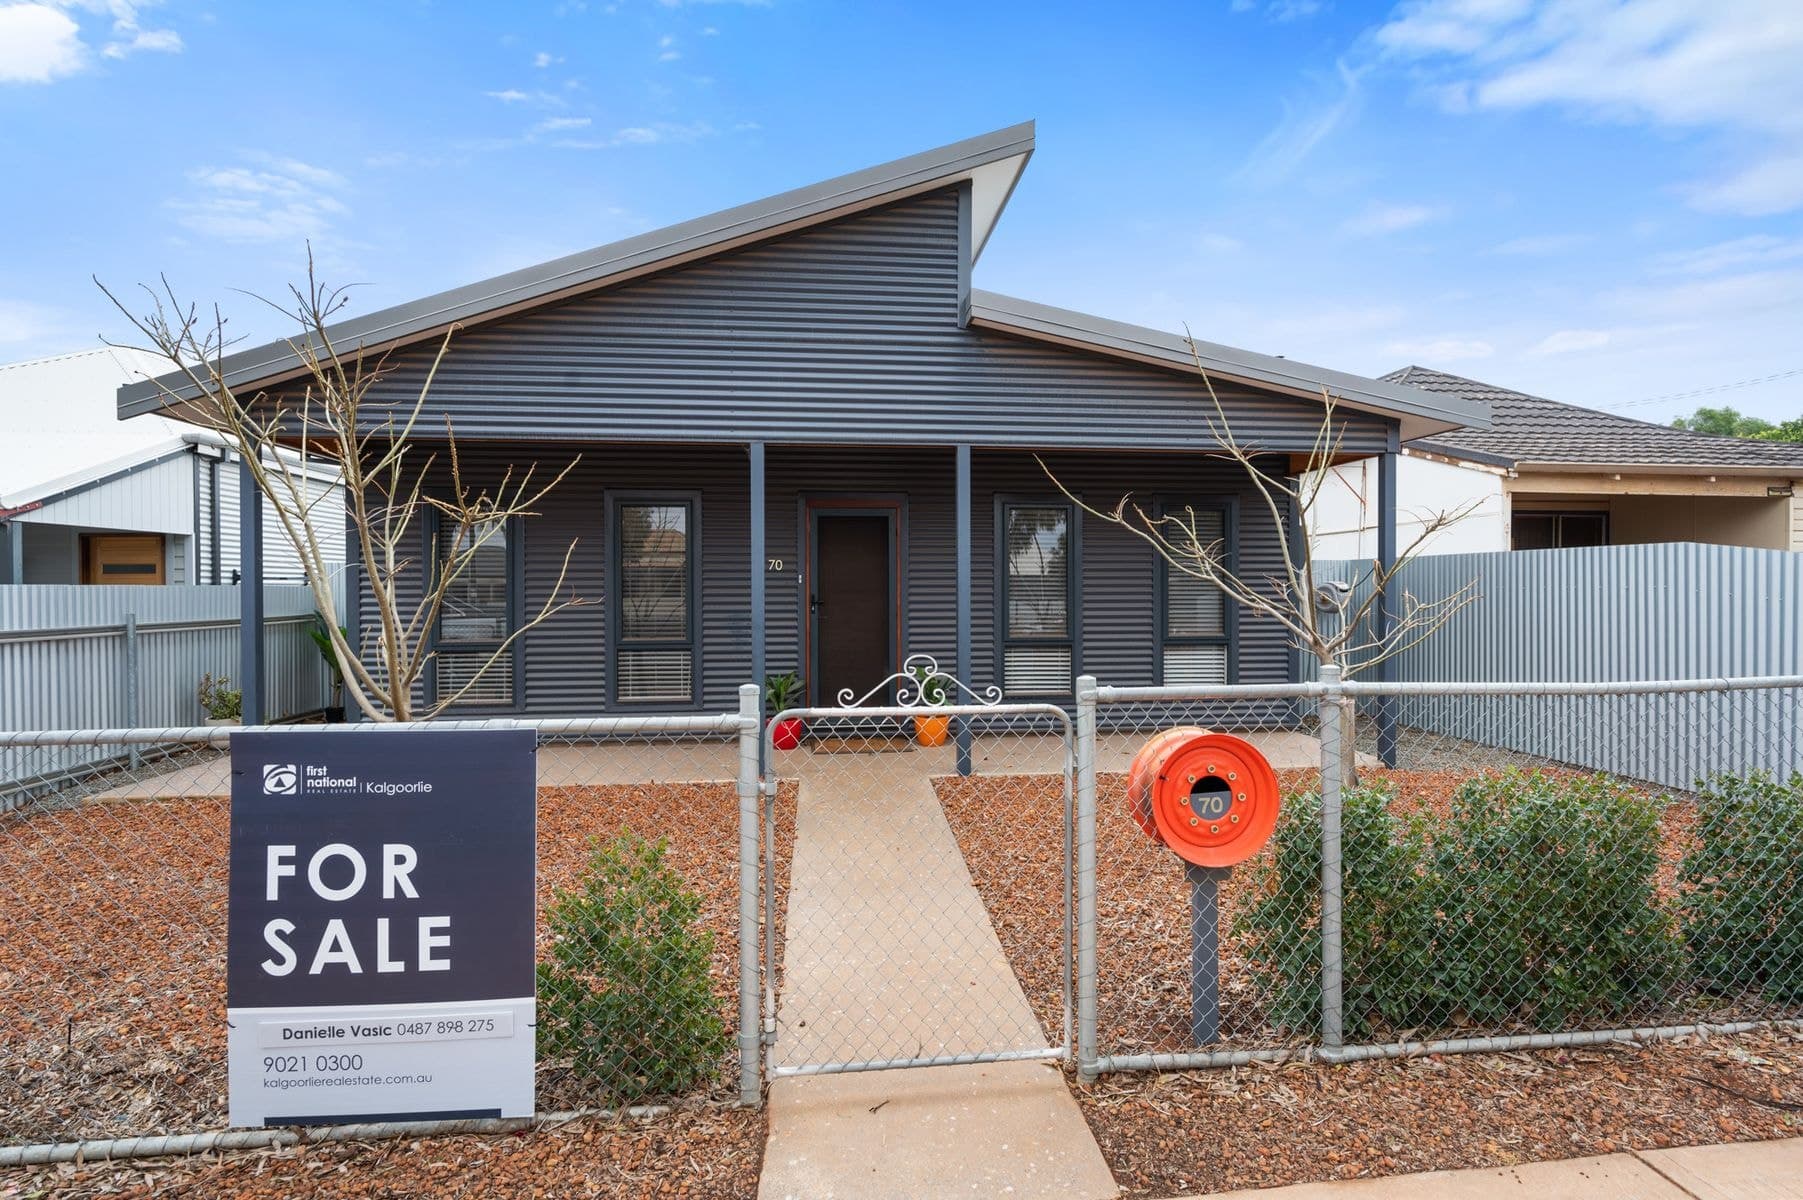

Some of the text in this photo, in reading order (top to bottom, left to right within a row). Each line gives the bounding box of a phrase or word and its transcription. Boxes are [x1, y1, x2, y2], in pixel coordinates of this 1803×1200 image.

[768, 559, 783, 571] 70
[306, 765, 327, 777] first
[306, 776, 357, 788] national
[366, 780, 433, 796] Kalgoorlie
[1198, 796, 1224, 814] 70
[266, 843, 420, 902] FOR
[261, 916, 451, 977] SALE
[282, 1019, 495, 1040] Danielle Vasic 0487 898 275
[263, 1054, 363, 1073] 9021 0300
[263, 1074, 433, 1089] kalgoorlierealestate.com.au
